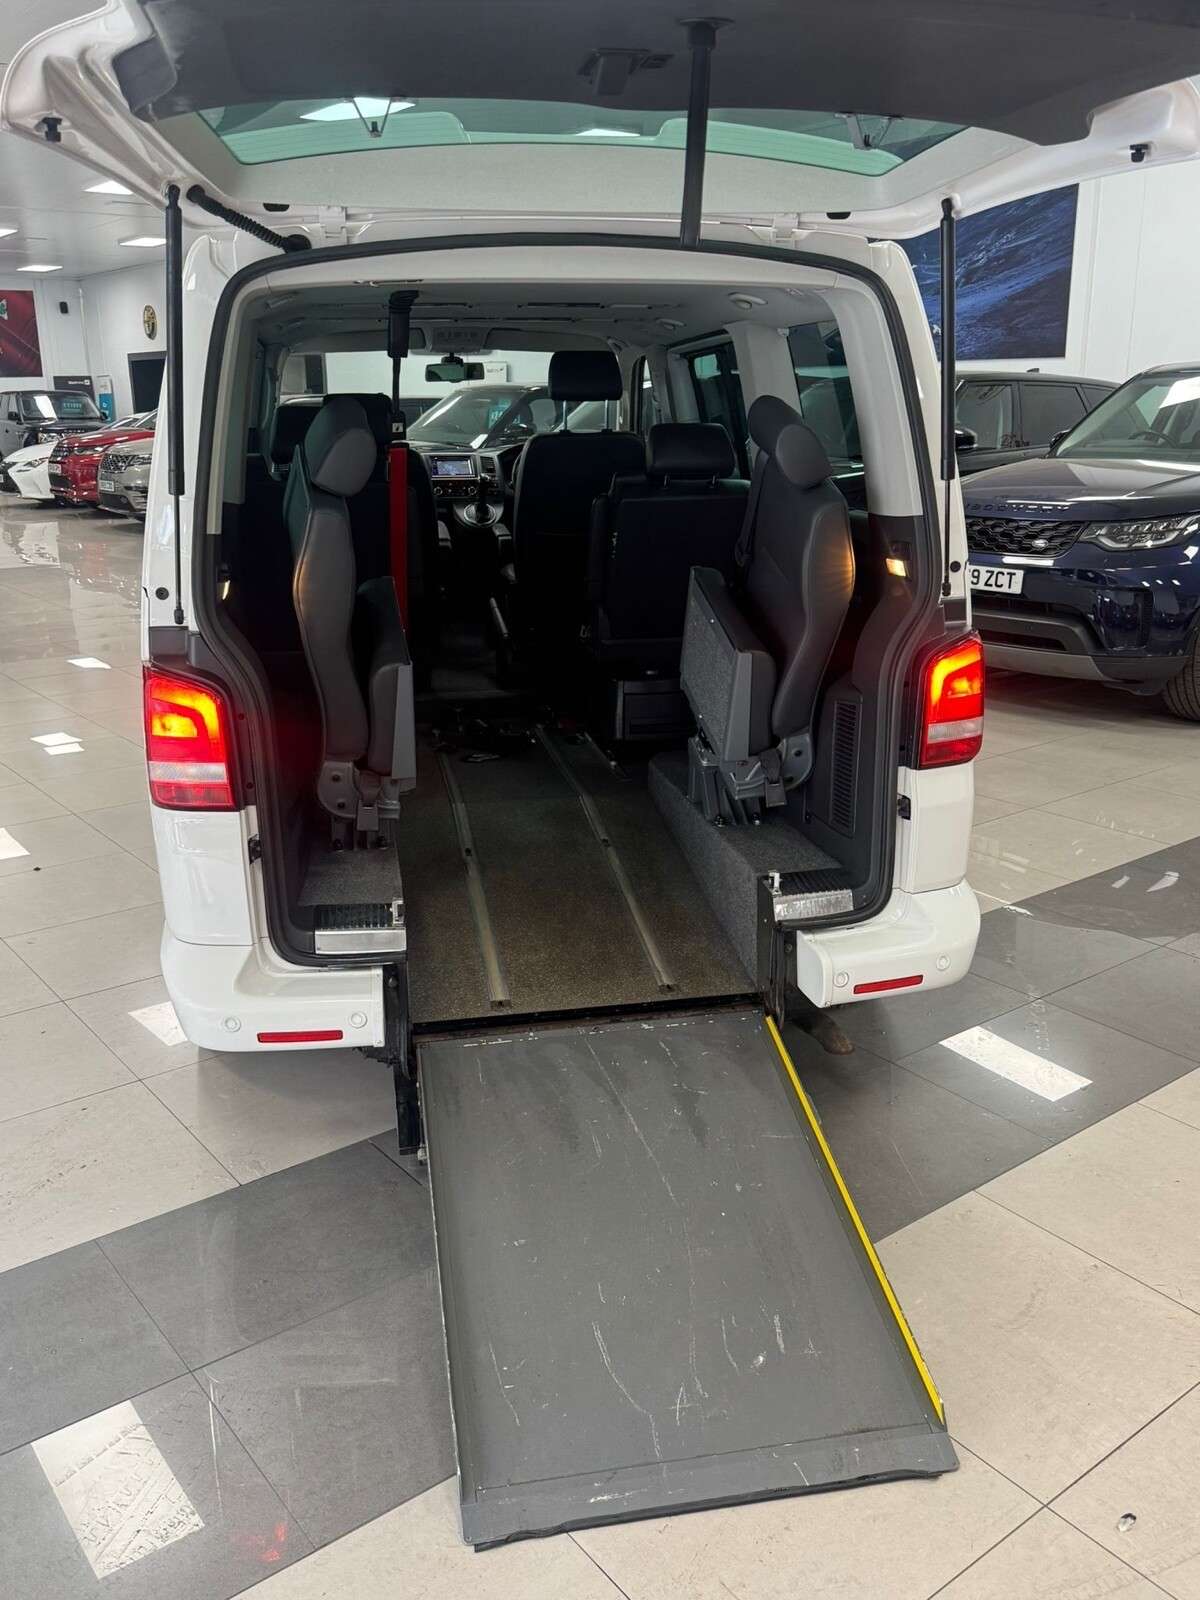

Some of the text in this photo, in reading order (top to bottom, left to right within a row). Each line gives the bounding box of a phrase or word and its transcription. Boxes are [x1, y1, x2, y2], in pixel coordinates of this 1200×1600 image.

[966, 503, 1070, 513] ISCOVERY
[968, 568, 1017, 590] 9 ZCT
